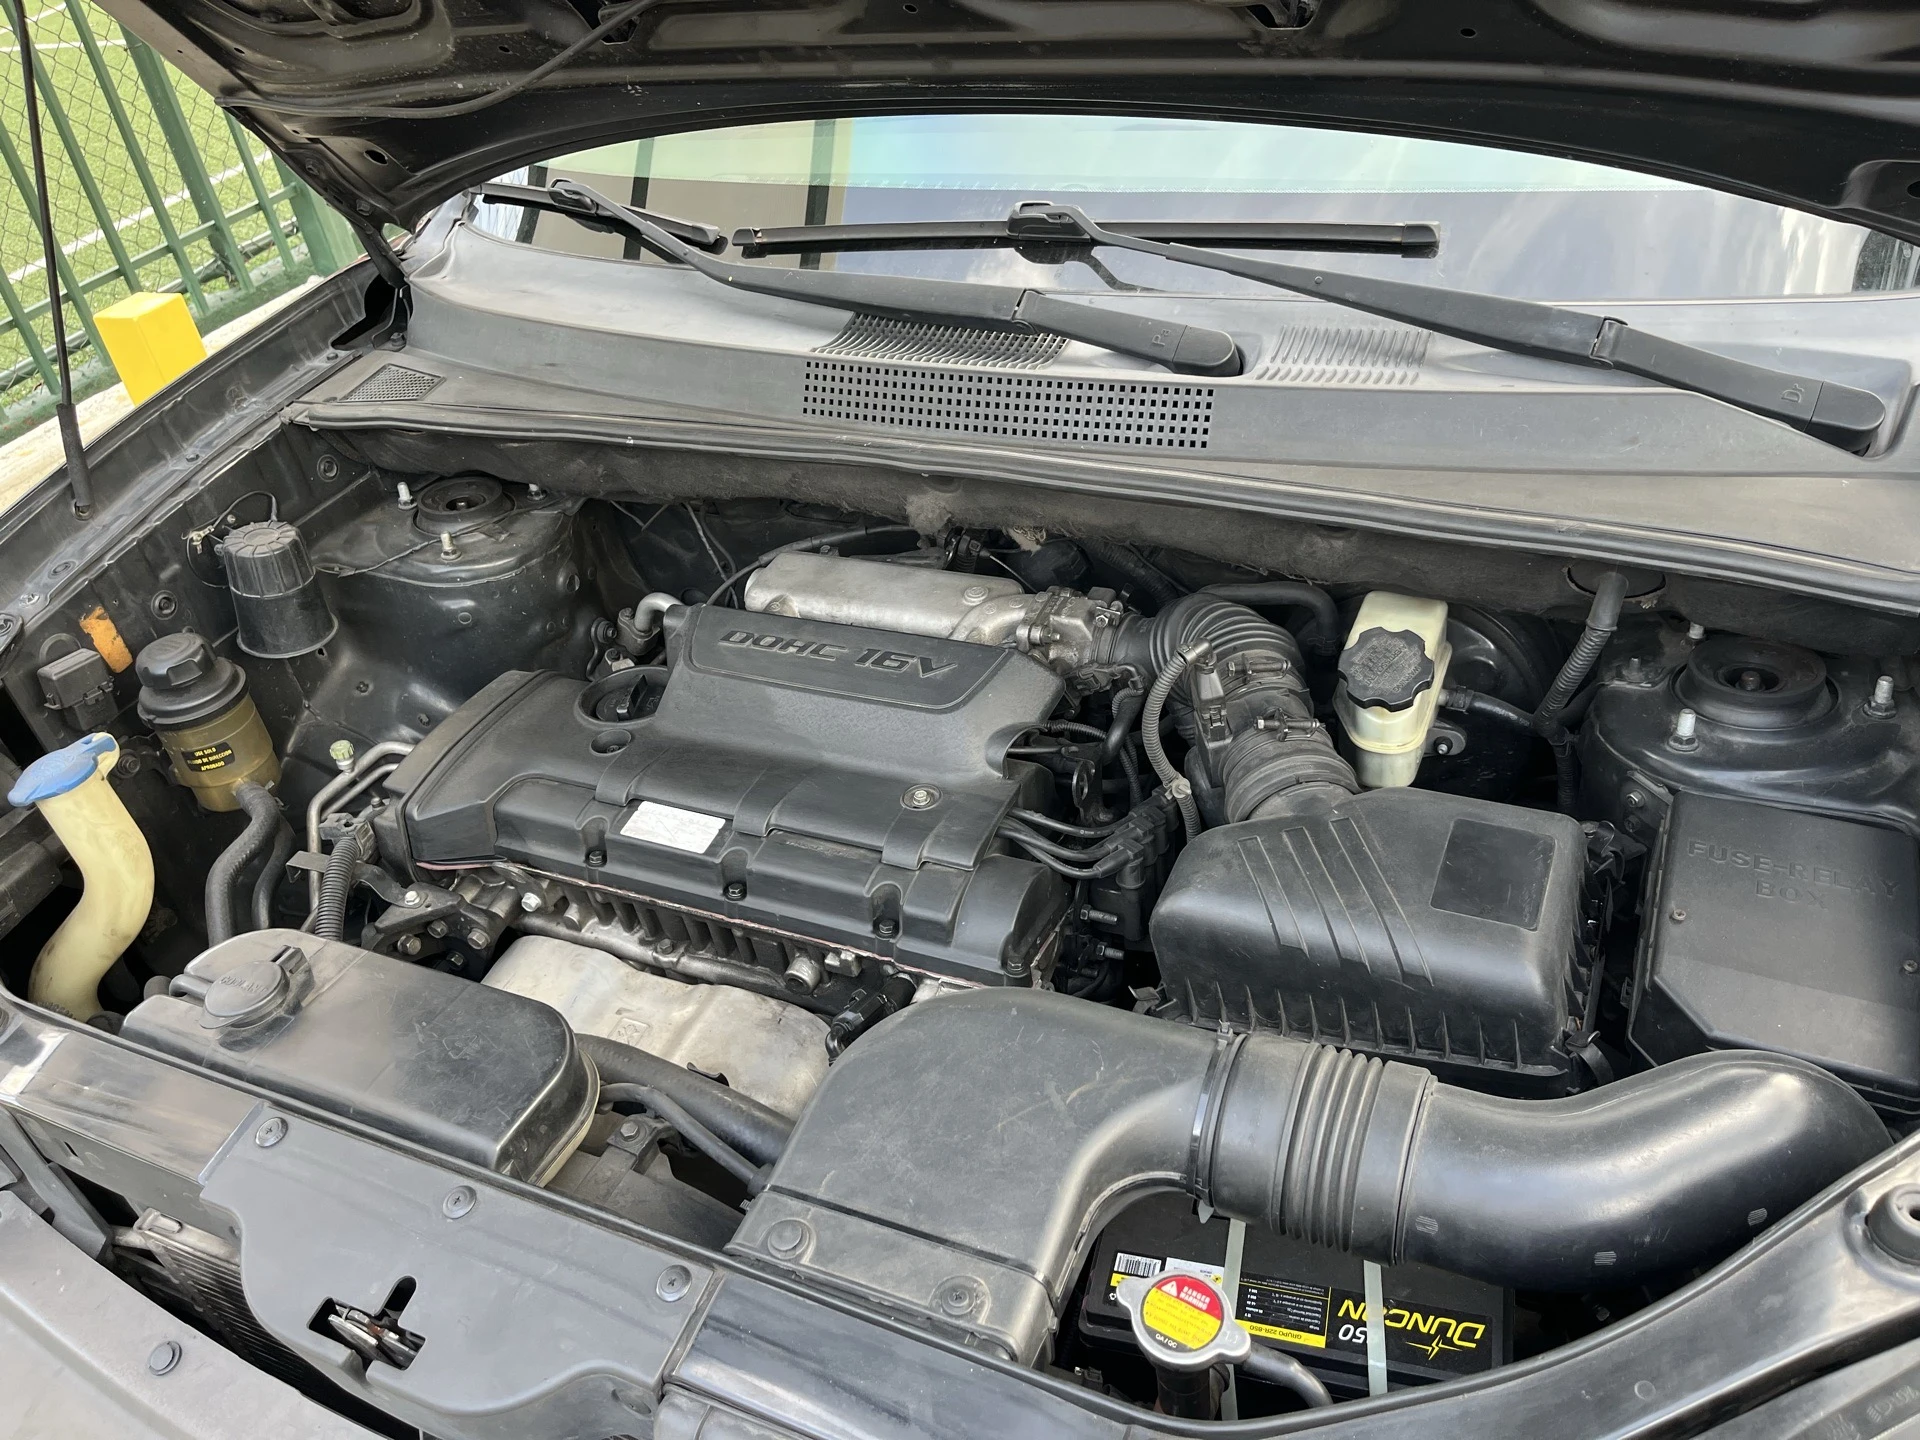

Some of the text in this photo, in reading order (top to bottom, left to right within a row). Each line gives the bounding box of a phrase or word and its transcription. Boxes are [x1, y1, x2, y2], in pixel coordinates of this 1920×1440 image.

[718, 630, 958, 678] DOHC 16V
[1688, 839, 1900, 898] FUSE-RELAY
[1756, 879, 1829, 911] BOX
[1180, 1291, 1207, 1310] WARNING
[1182, 1286, 1210, 1304] DANGER
[1278, 1330, 1302, 1340] GRUPO
[1338, 1323, 1369, 1344] 50
